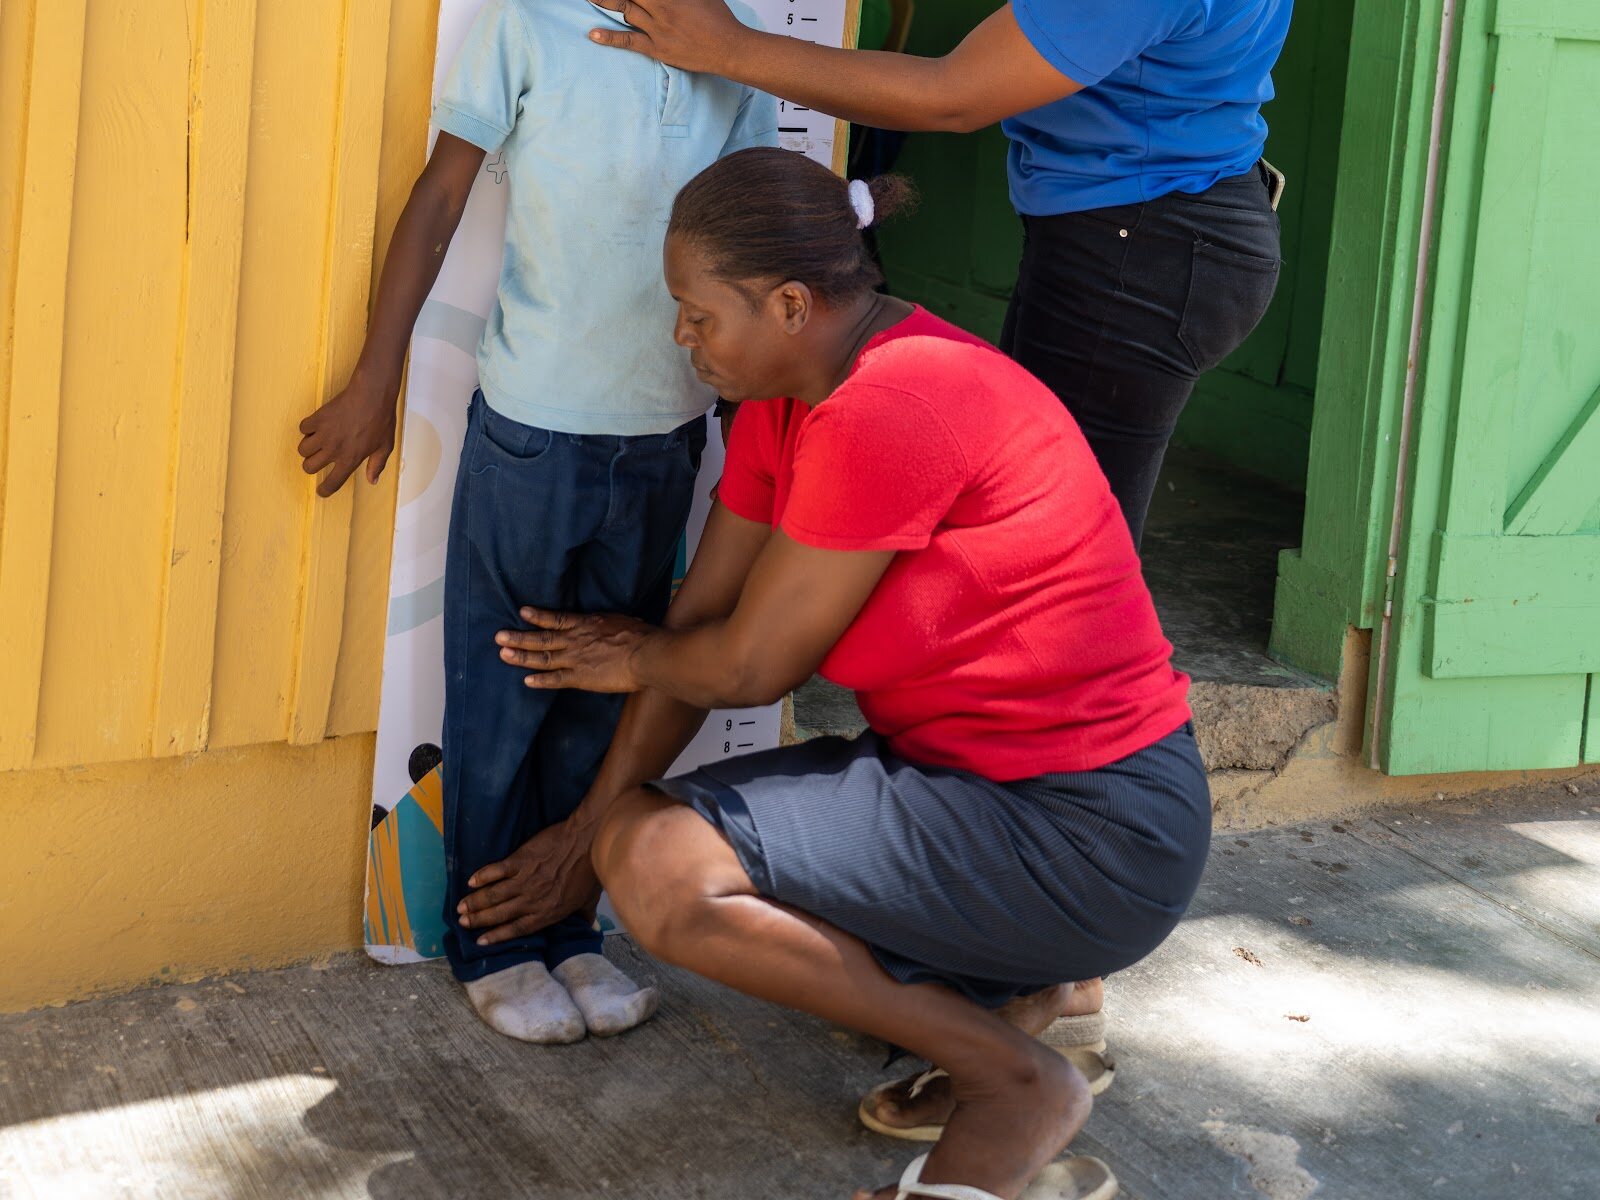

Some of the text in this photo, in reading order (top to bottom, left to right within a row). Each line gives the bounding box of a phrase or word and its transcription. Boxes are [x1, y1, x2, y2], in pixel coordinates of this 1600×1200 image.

[786, 13, 794, 26] 5
[725, 718, 733, 732] 9
[723, 741, 731, 754] 8
